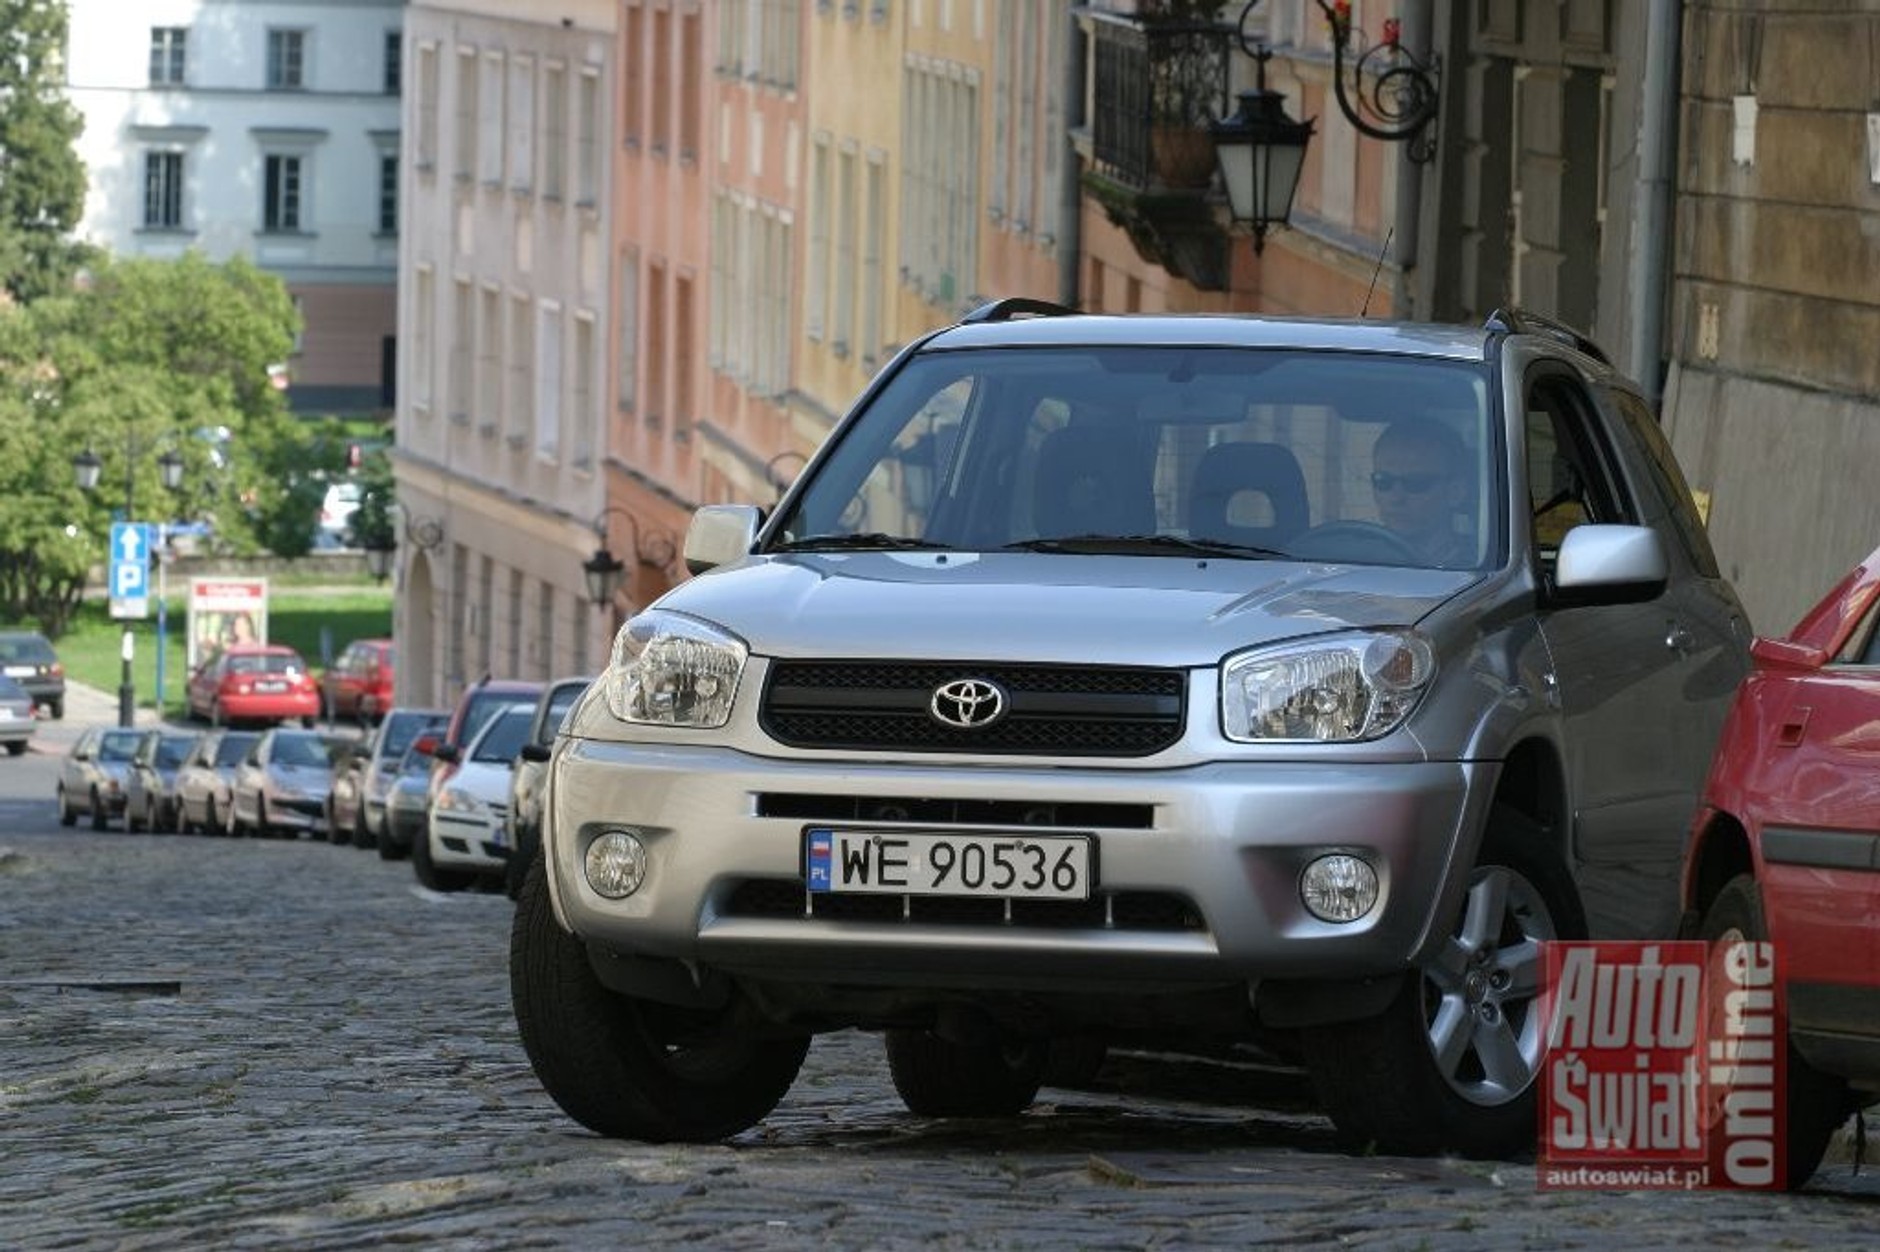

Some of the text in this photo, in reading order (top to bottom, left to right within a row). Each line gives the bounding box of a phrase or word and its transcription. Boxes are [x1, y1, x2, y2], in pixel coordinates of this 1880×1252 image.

[117, 565, 142, 596] P
[811, 867, 828, 880] PL
[841, 839, 1077, 891] WE 90536
